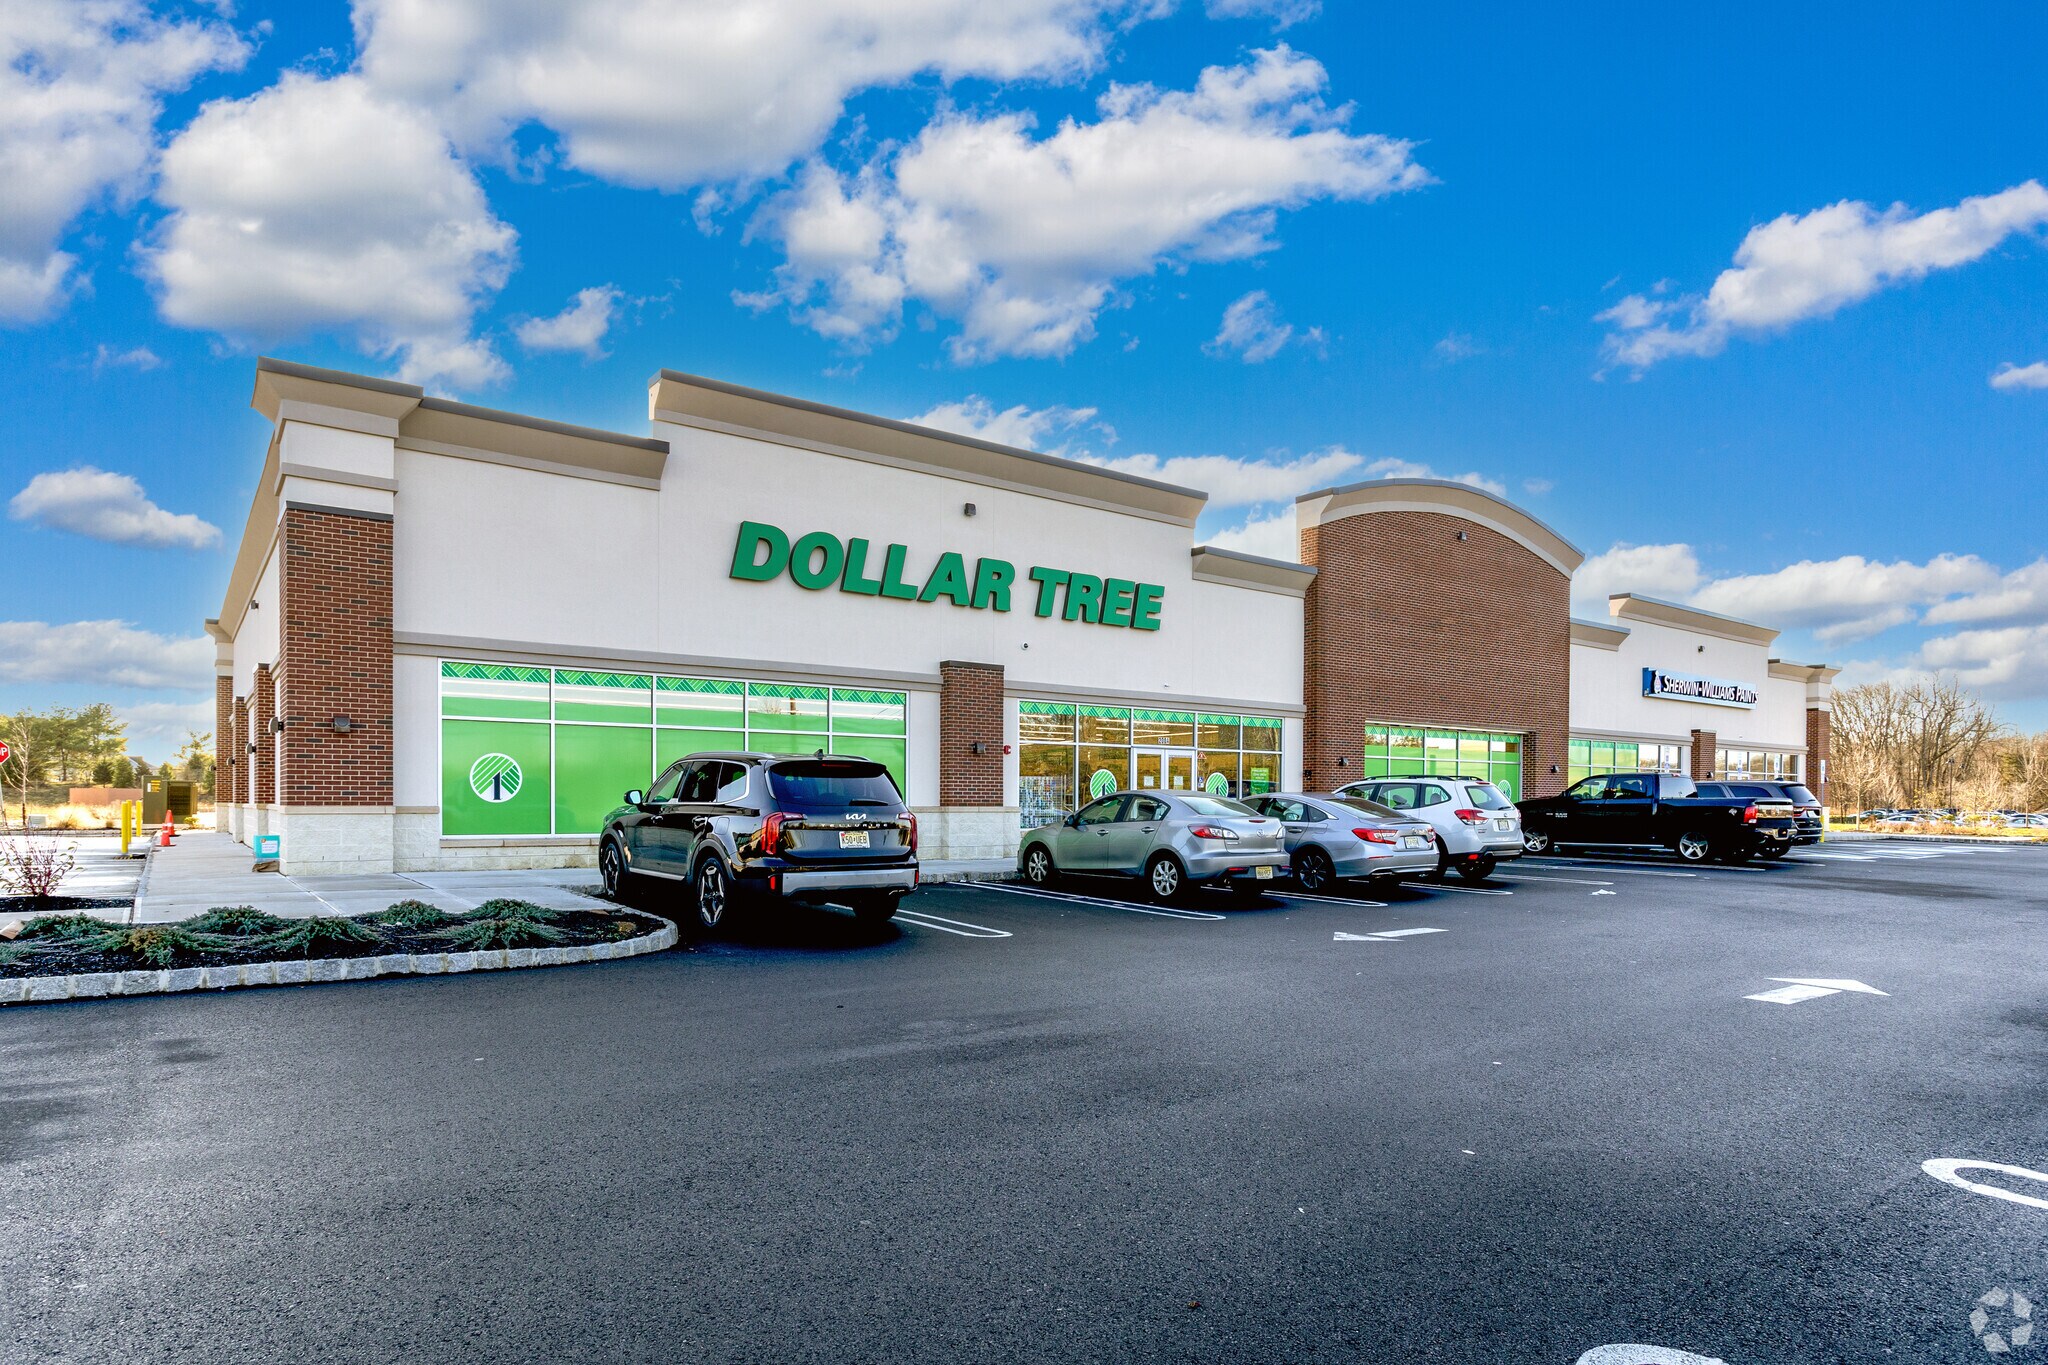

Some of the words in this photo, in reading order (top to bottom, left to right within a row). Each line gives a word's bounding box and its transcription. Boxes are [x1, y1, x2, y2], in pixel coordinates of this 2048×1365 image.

[729, 520, 1016, 612] DOLLAR
[1029, 566, 1165, 631] TREE
[1663, 675, 1736, 701] SHERWIN-WILLIAMS
[1736, 686, 1759, 704] PAINTS
